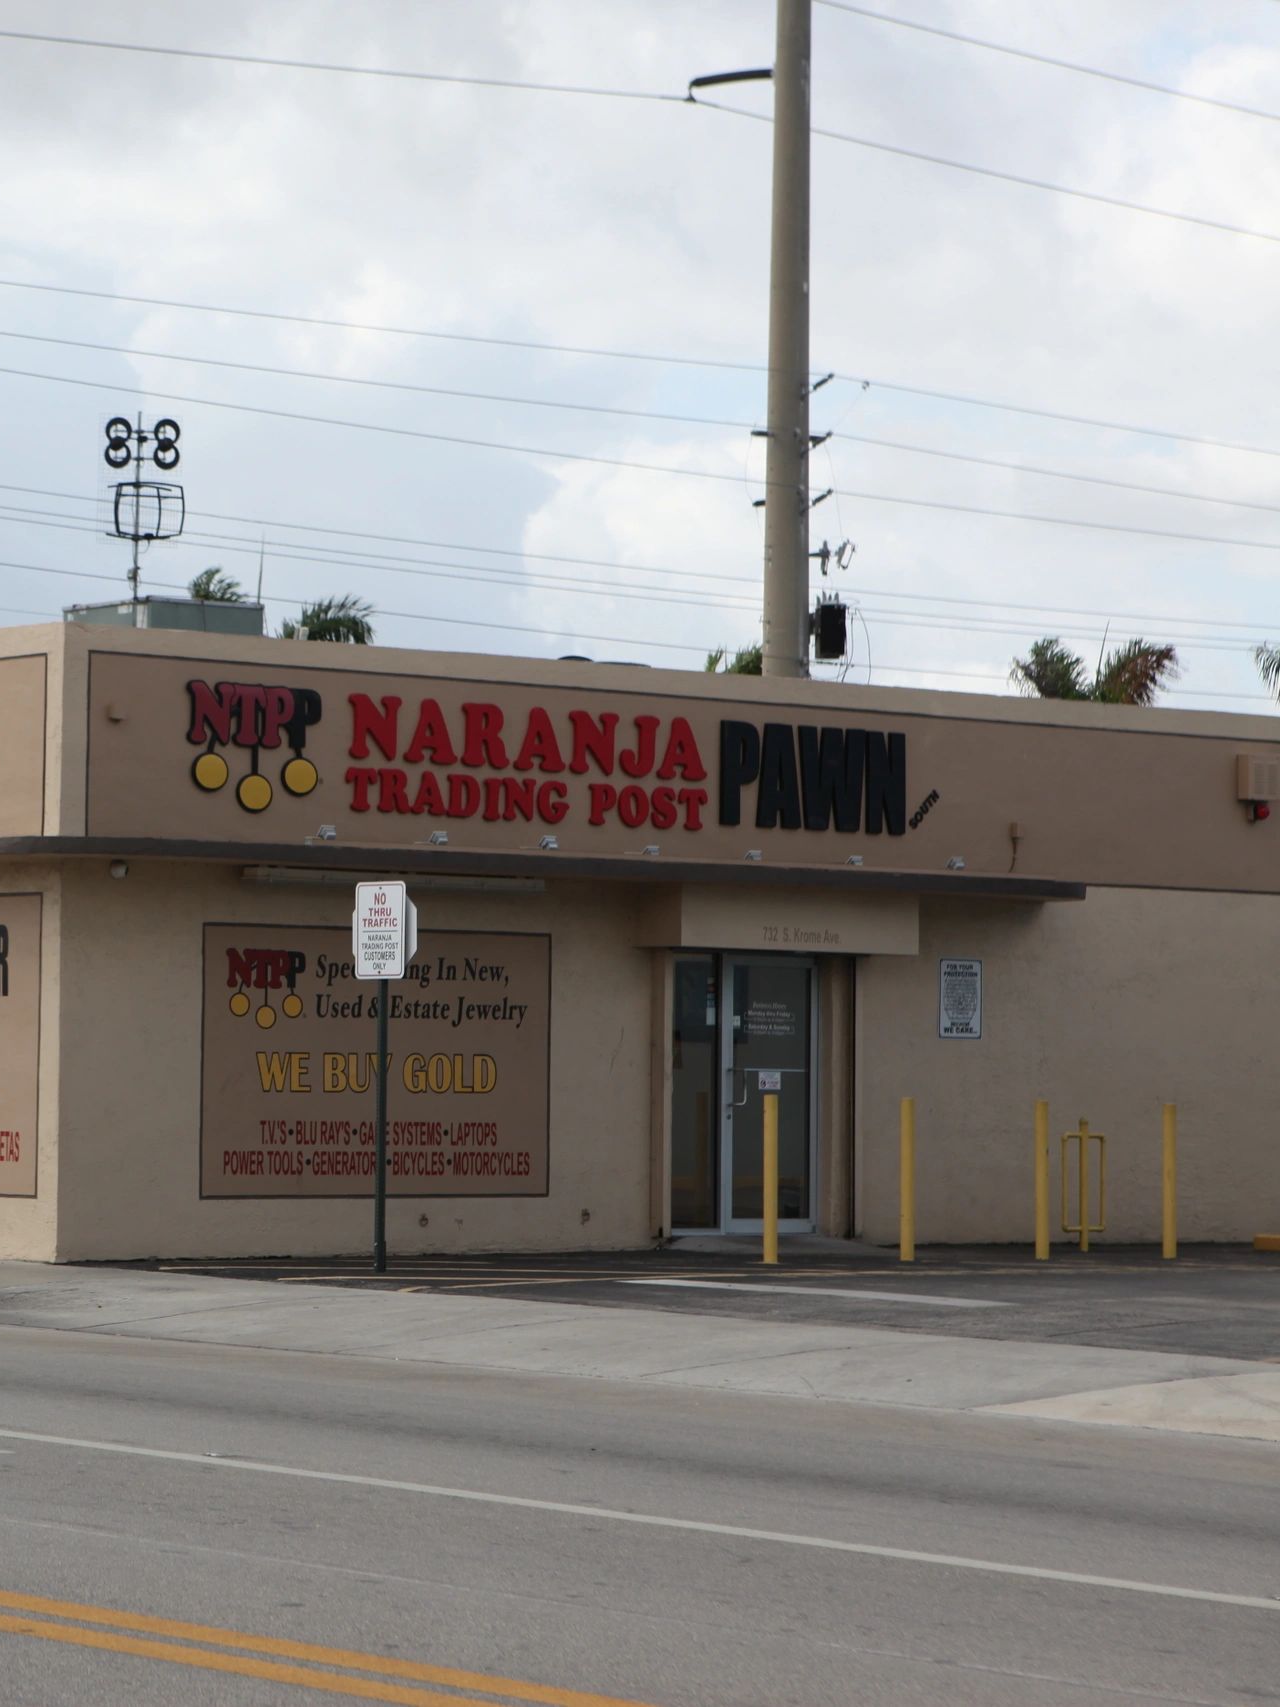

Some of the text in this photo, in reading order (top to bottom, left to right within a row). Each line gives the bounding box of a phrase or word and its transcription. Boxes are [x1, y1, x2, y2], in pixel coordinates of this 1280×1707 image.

[347, 693, 708, 782] NARANJA
[718, 719, 906, 837] PAWN
[345, 767, 708, 831] TRADING POST
[909, 789, 939, 830] SOUTH
[374, 892, 387, 905] NO
[362, 918, 398, 928] TRAFFIC
[368, 907, 392, 917] THRU
[361, 942, 399, 950] TRADING POST
[367, 934, 392, 942] NARANJA
[762, 926, 779, 942] 732
[793, 927, 822, 945] Krome
[363, 951, 396, 961] CUSTOMERS
[372, 961, 387, 970] ONLY
[436, 957, 457, 981] In
[461, 958, 510, 987] New,
[316, 993, 363, 1018] Used
[389, 995, 450, 1020] Estate
[451, 996, 528, 1029] Jewelry
[256, 1051, 312, 1093] WE
[403, 1052, 497, 1094] GOLD
[295, 1120, 317, 1145] BLU
[320, 1121, 351, 1146] RAY'S
[392, 1121, 442, 1146] SYSTEMS
[450, 1122, 497, 1147] LAPTOPS
[223, 1150, 530, 1176] POWER TOOLS GENERATOR BICYCLES MOTORCYCLES
